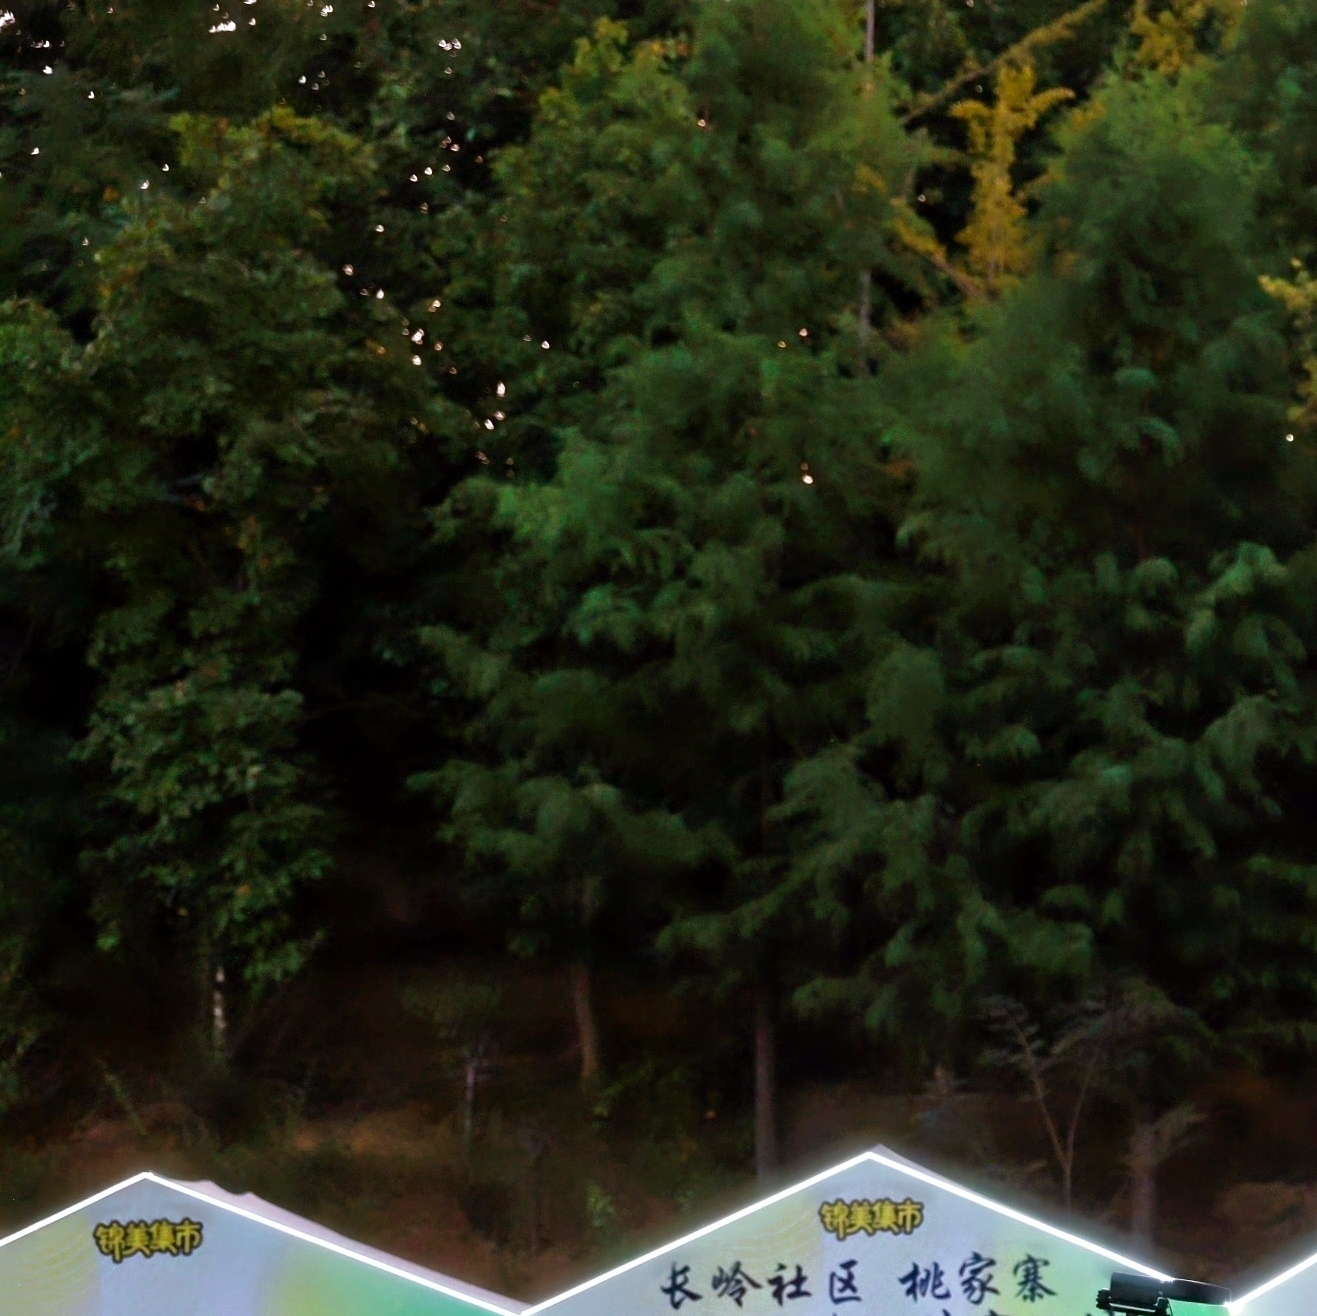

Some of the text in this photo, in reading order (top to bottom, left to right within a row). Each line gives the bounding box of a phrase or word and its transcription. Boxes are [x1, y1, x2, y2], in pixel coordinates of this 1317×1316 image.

[660, 1252, 1058, 1311] 长岭社区 桃家寨
